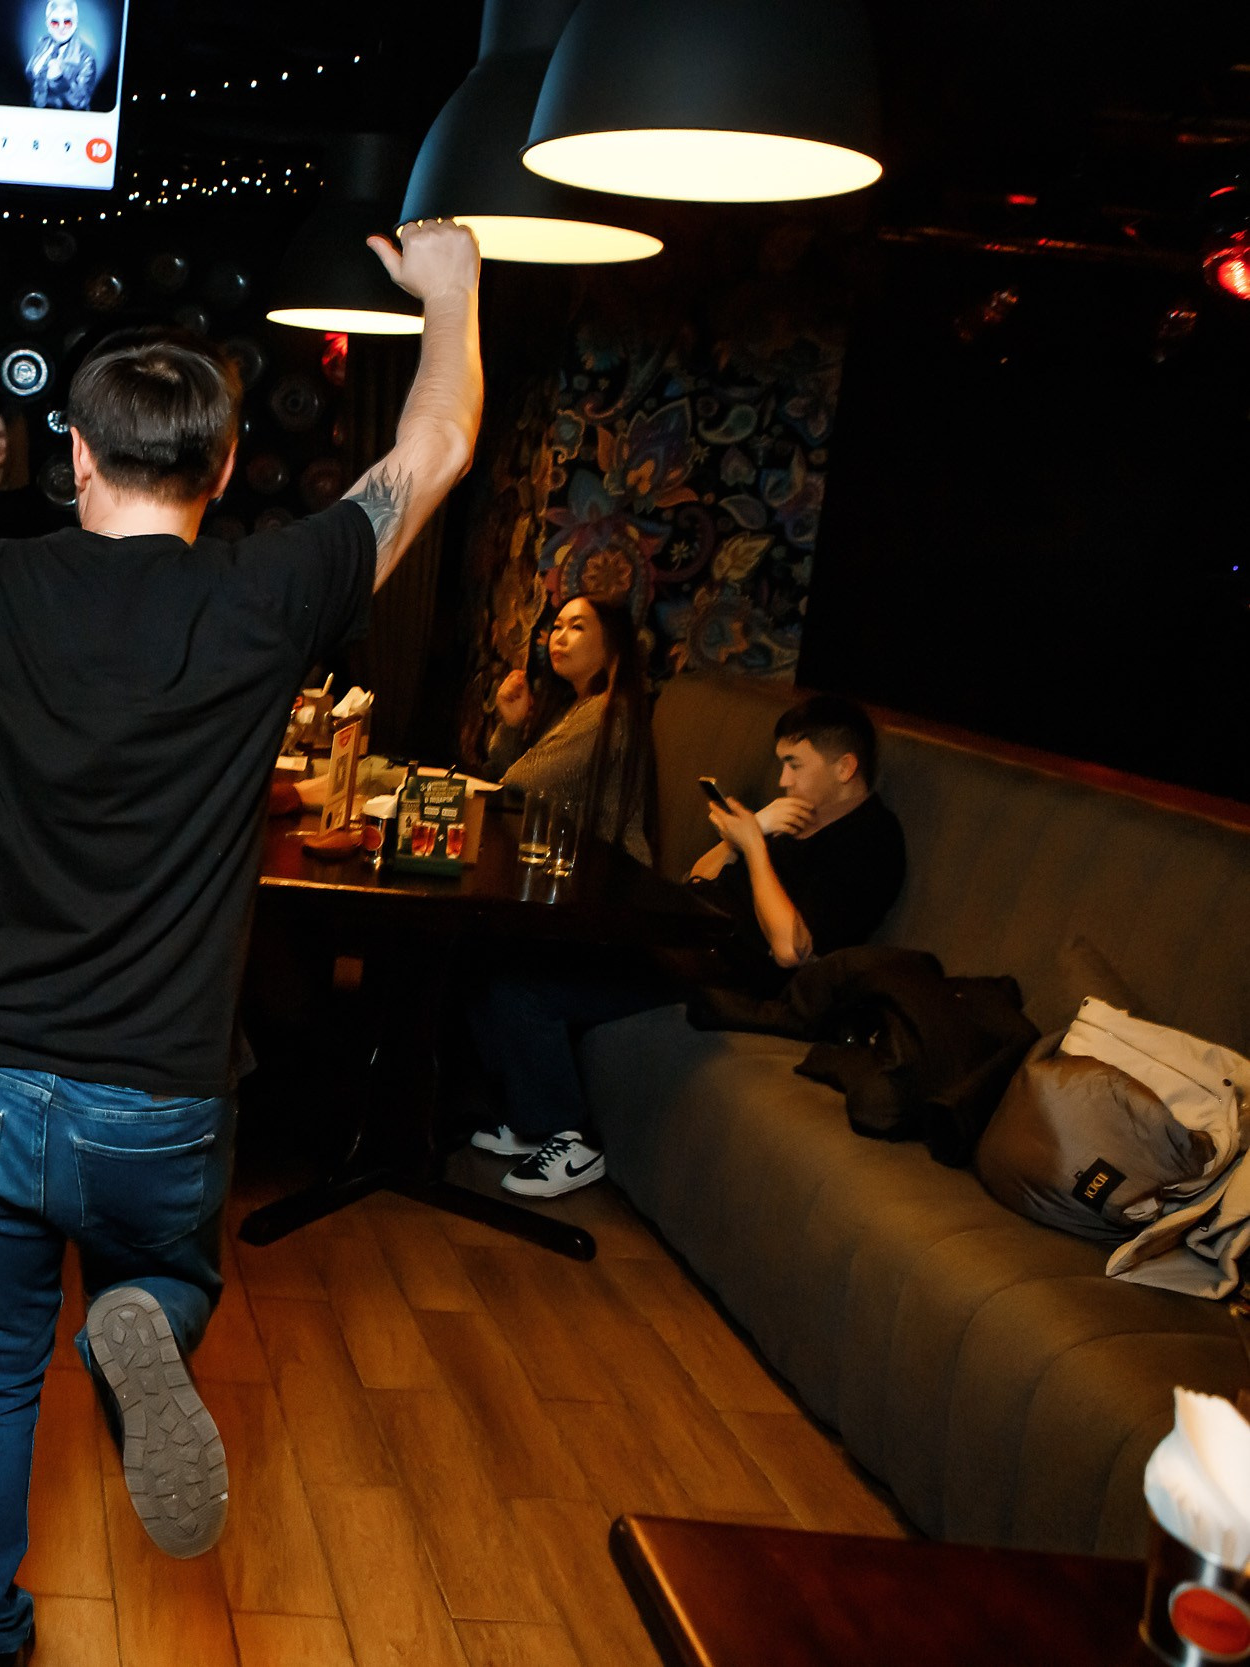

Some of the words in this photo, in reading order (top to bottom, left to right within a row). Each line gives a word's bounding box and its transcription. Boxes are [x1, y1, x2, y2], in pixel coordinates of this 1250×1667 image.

[2, 137, 8, 148] 7
[32, 139, 39, 151] 8
[64, 141, 71, 153] 9
[91, 142, 108, 158] 10
